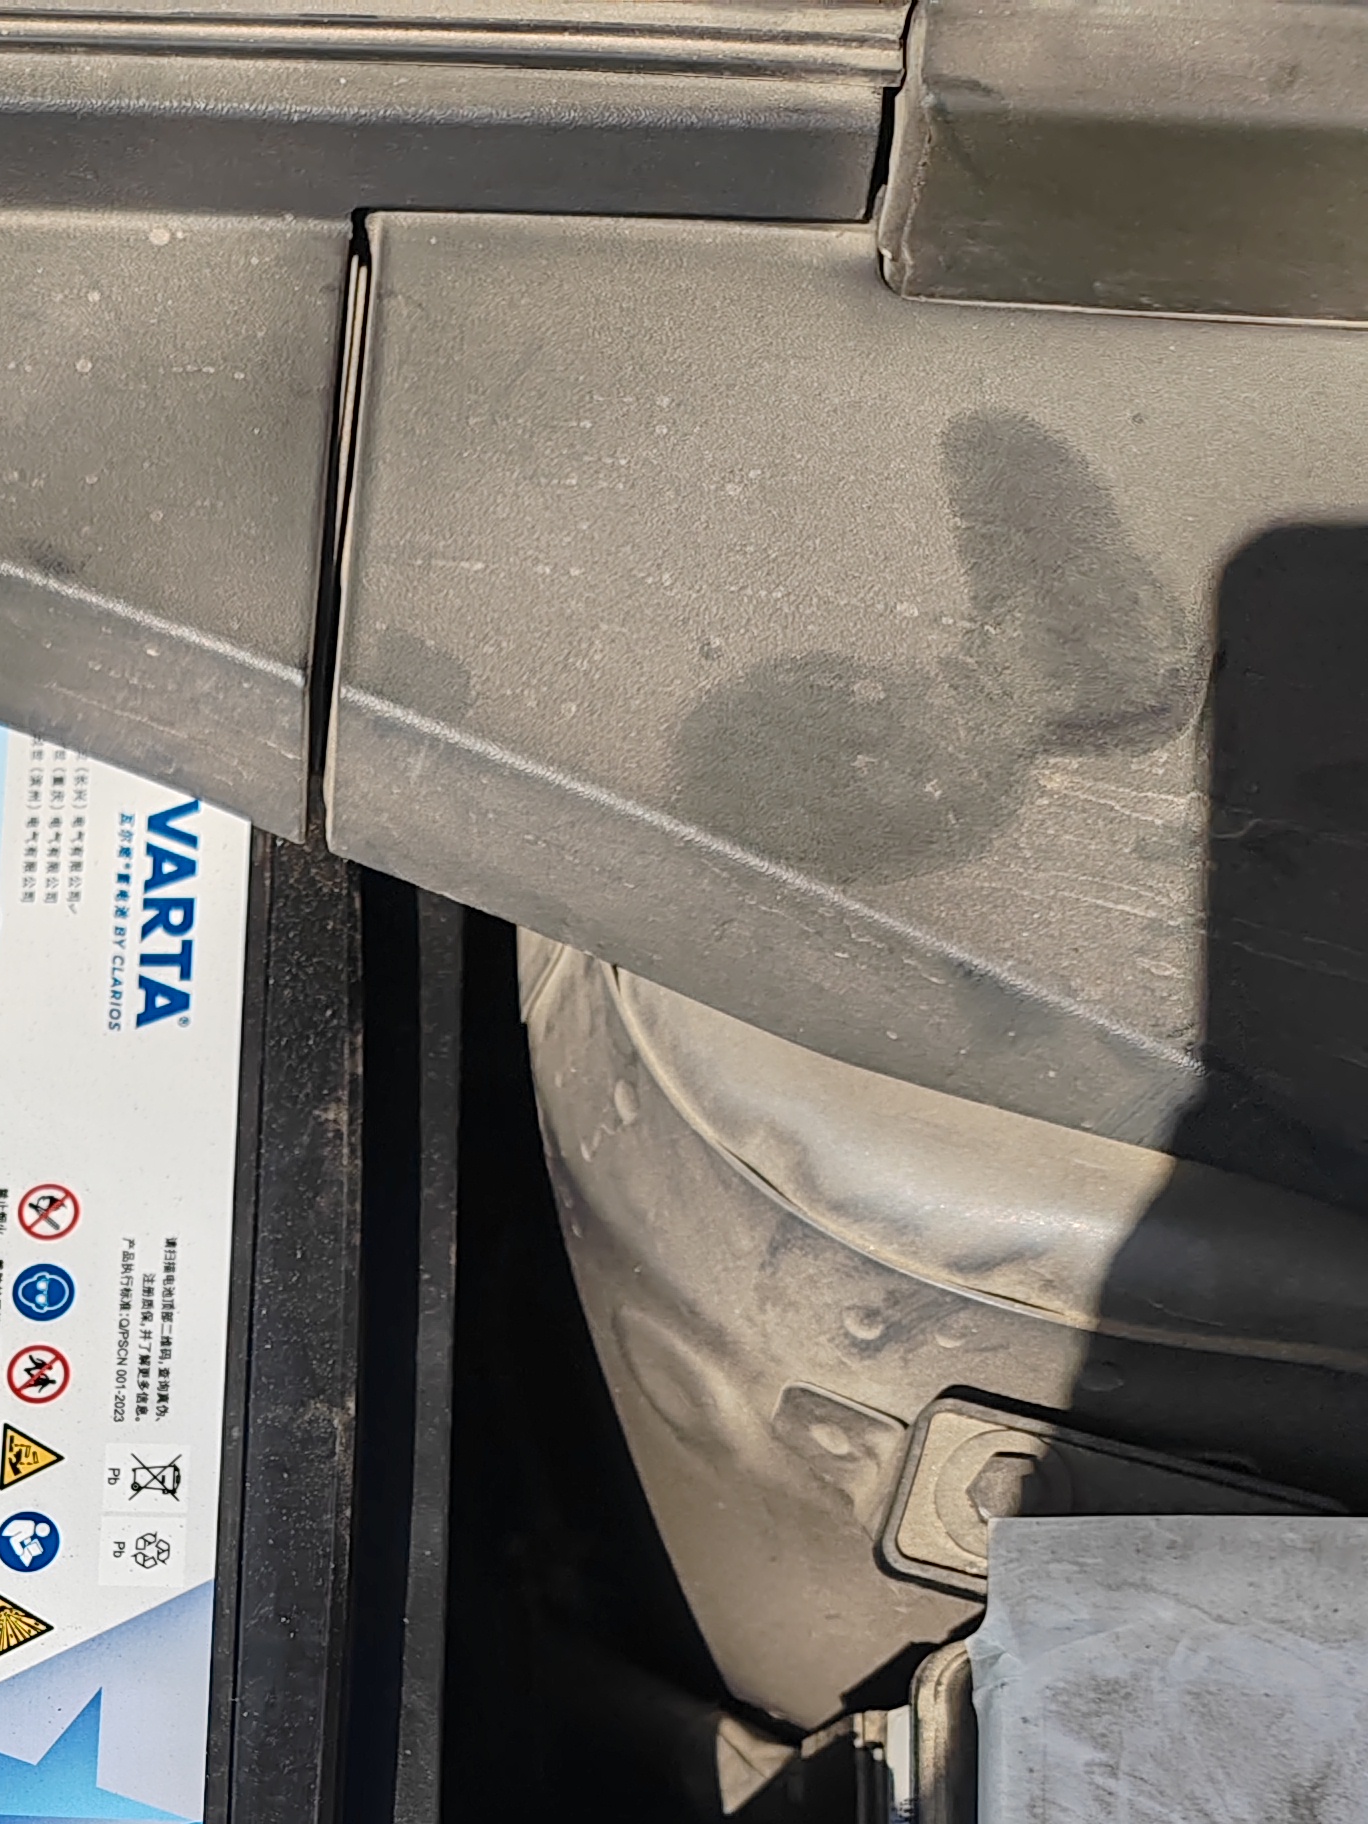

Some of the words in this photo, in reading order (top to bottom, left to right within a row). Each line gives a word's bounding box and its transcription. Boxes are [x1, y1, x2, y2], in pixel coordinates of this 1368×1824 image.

[113, 926, 126, 949] BY
[108, 955, 123, 1031] CLARIOS
[106, 1468, 119, 1486] Pb
[112, 1541, 124, 1558] Pb
